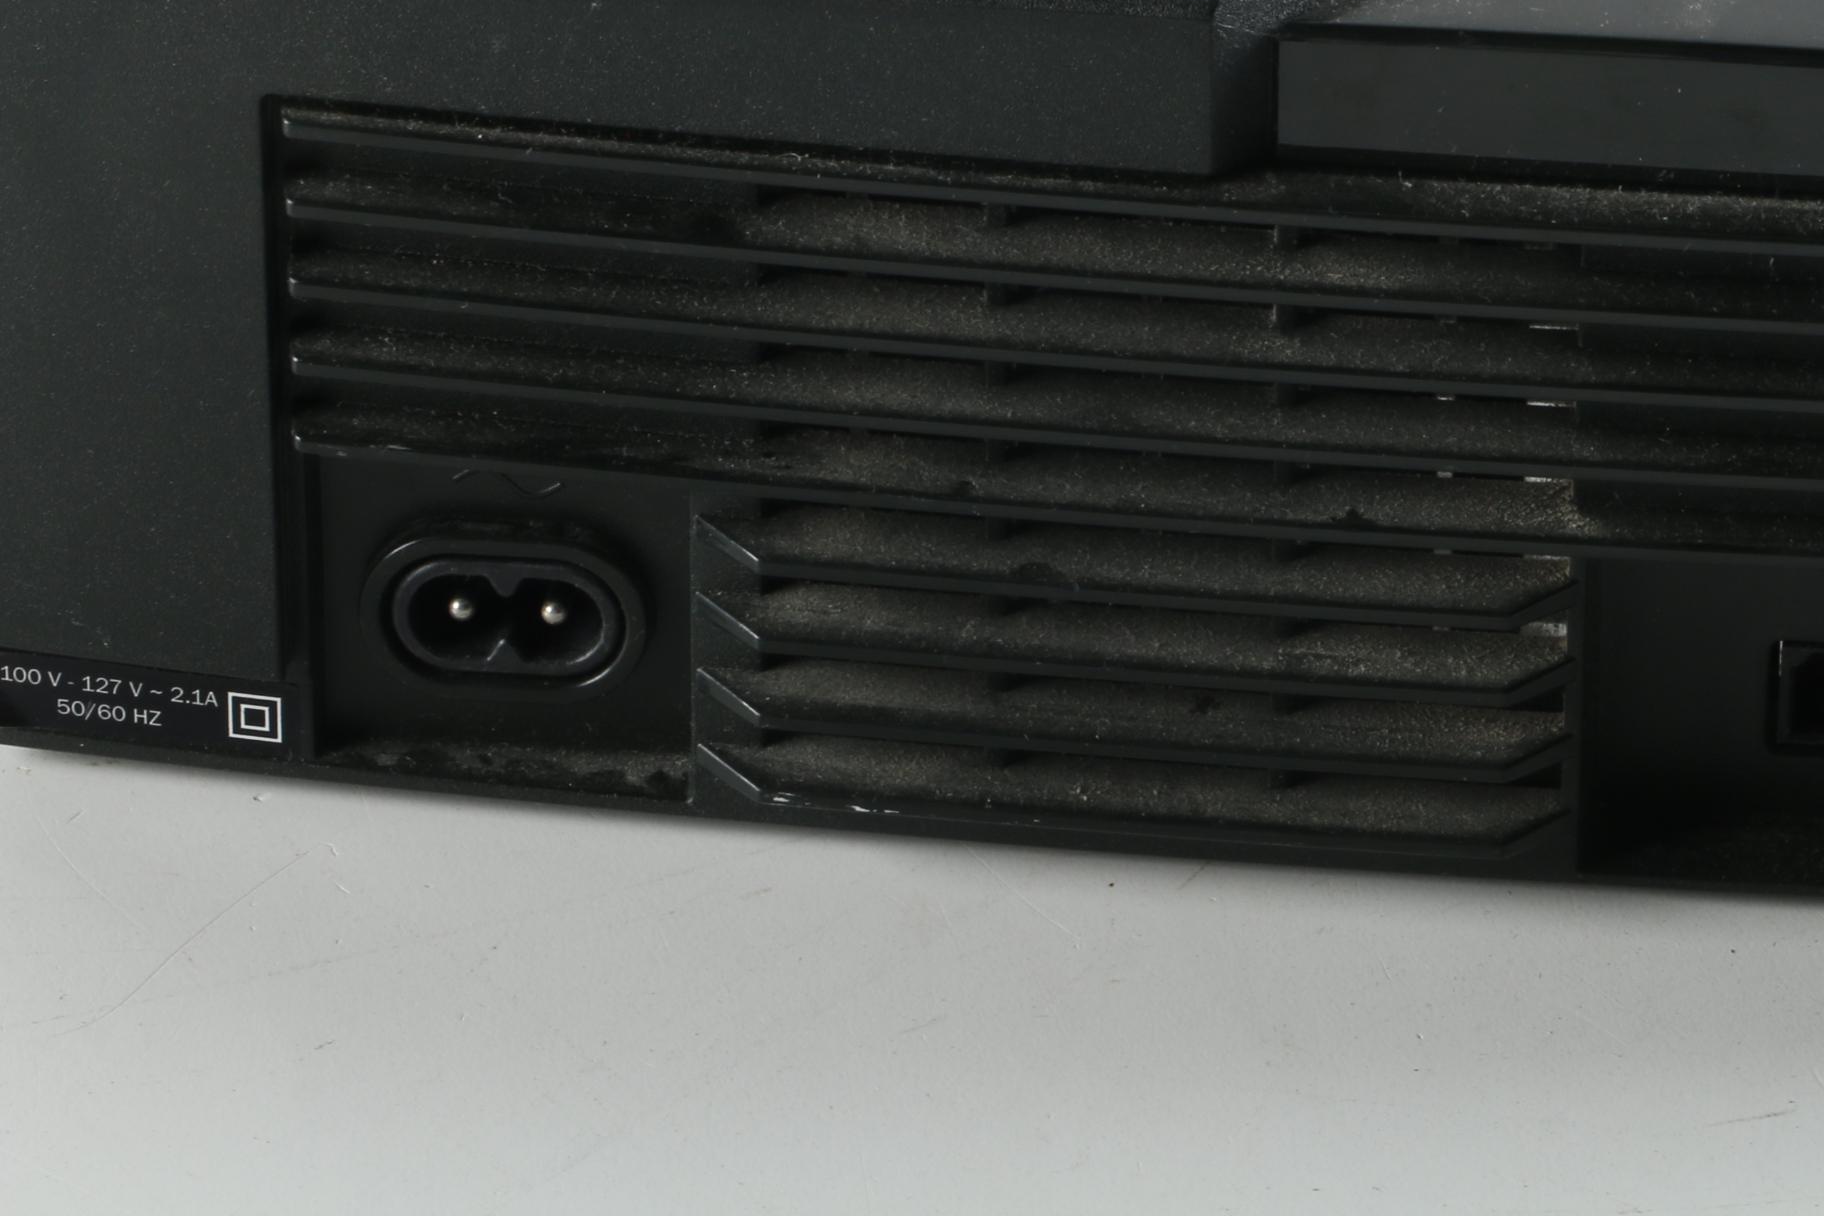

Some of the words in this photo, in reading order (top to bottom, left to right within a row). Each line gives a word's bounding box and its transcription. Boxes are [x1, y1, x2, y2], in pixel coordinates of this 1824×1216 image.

[0, 665, 42, 685] 100
[47, 671, 62, 687] V
[81, 675, 123, 695] 127
[128, 681, 144, 698] V
[169, 687, 219, 707] 2.1A
[56, 698, 127, 722] 50/60
